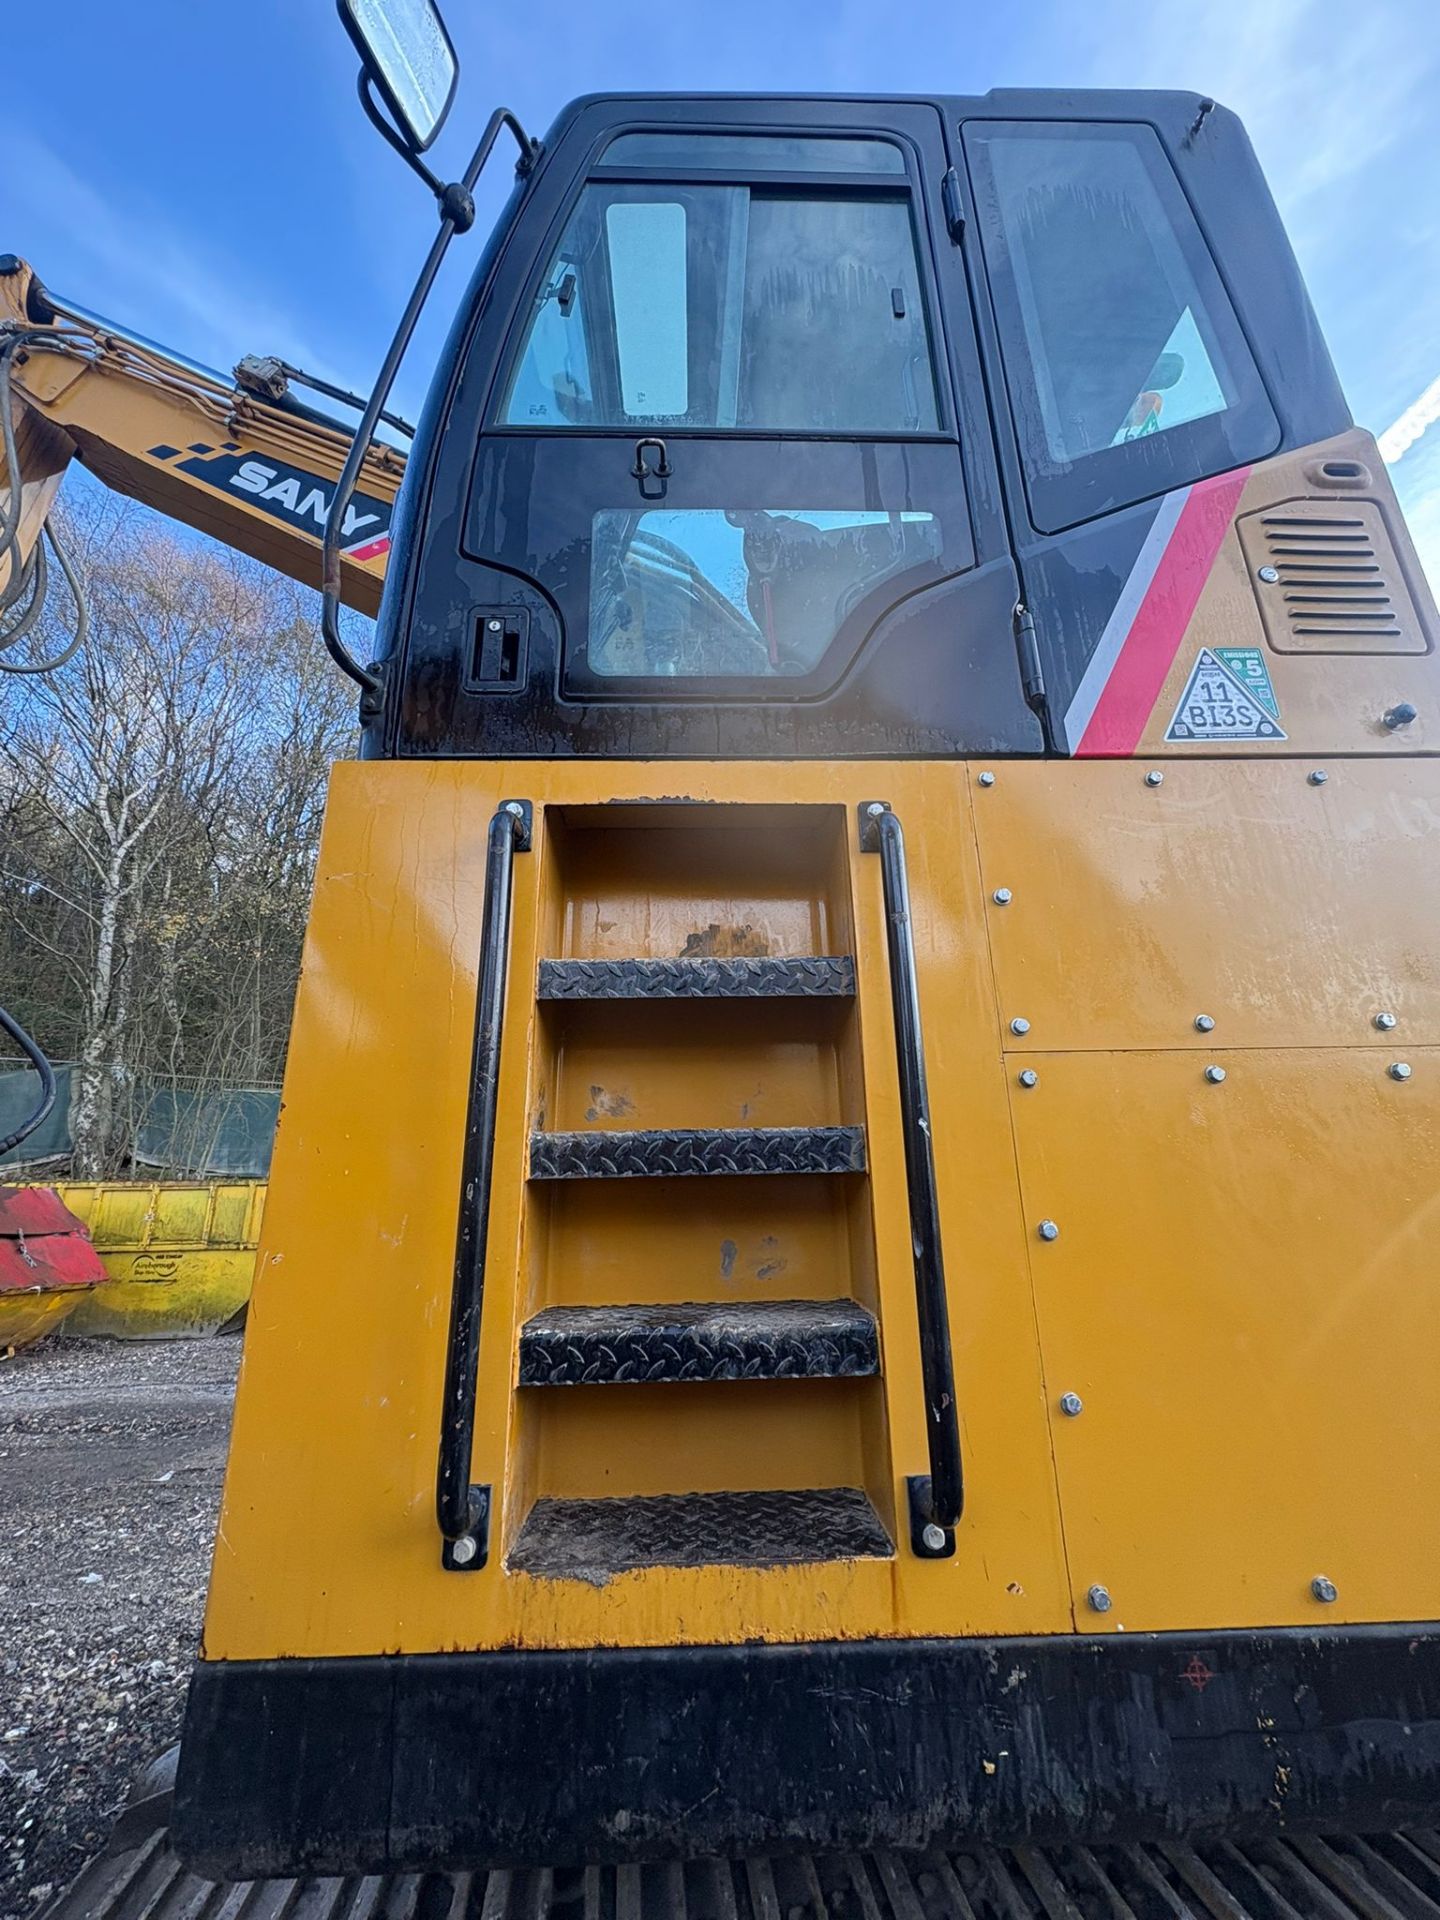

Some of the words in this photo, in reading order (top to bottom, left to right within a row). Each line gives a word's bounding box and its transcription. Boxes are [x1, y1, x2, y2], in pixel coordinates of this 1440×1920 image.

[229, 461, 380, 536] SANY
[1246, 659, 1262, 676] 5
[1200, 682, 1233, 703] 11
